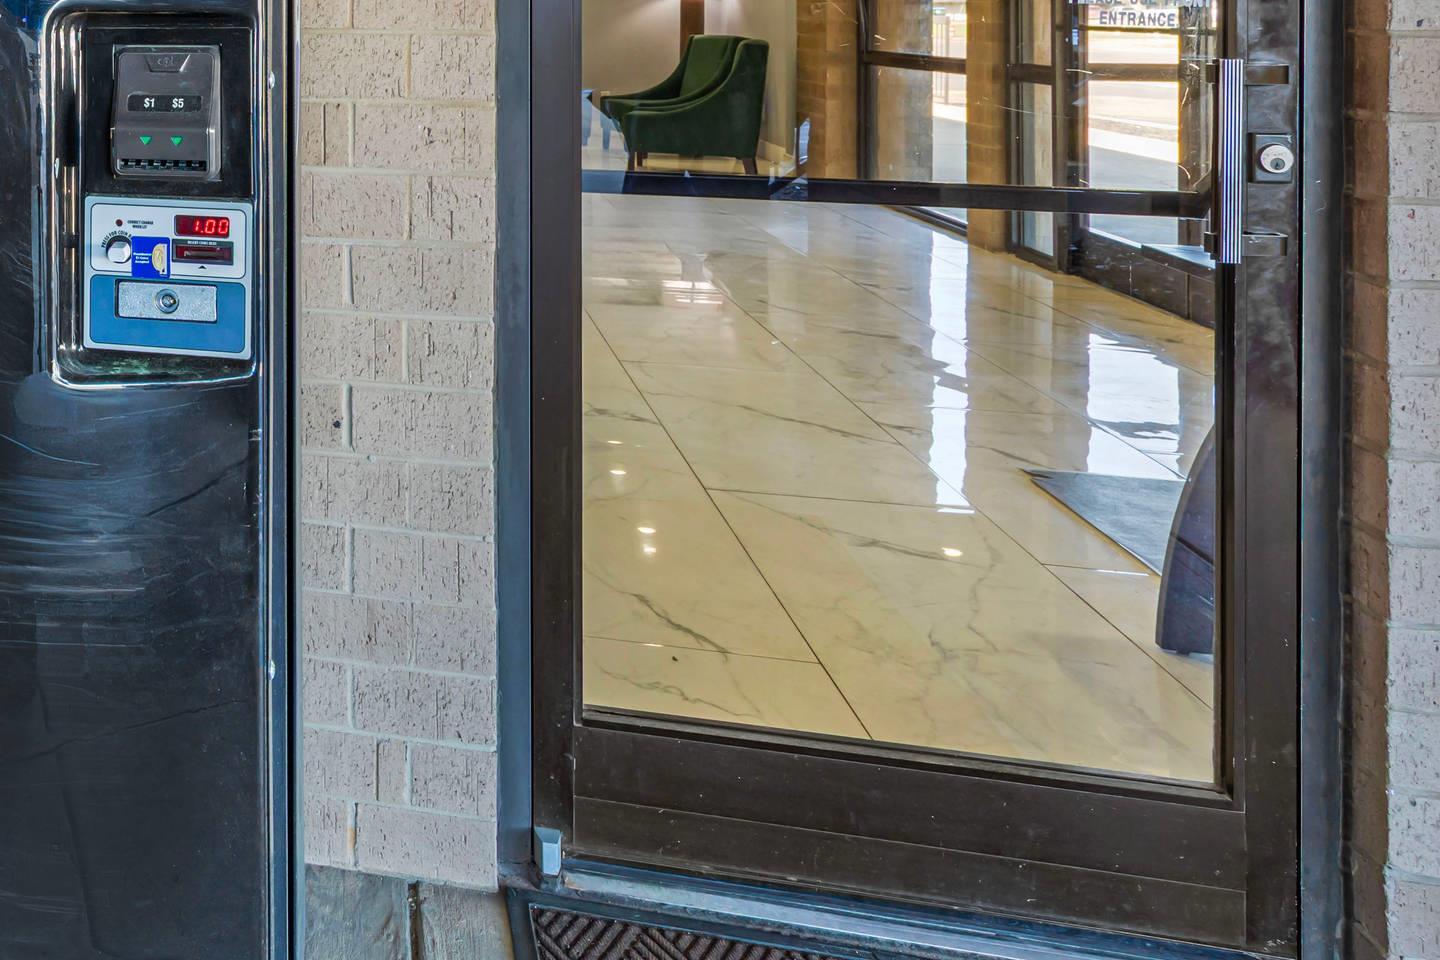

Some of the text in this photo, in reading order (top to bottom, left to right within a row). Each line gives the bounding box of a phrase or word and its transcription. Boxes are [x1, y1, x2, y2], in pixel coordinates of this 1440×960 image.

[144, 98, 184, 108] $1 $5
[194, 220, 229, 234] 1.00
[101, 235, 110, 248] PRESS
